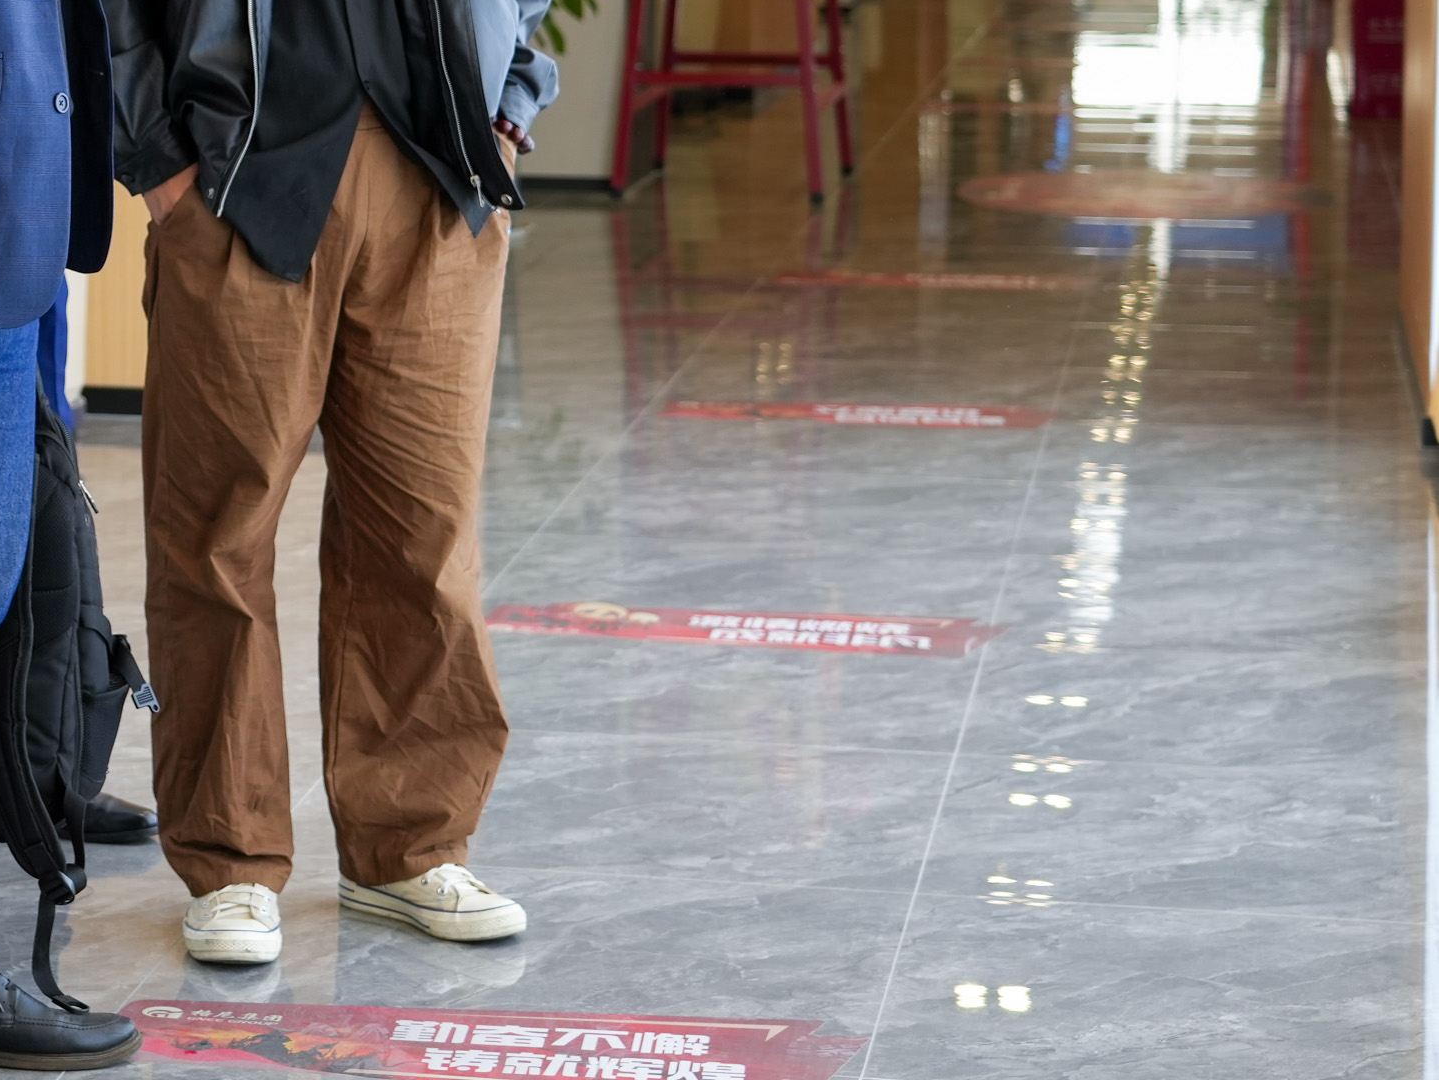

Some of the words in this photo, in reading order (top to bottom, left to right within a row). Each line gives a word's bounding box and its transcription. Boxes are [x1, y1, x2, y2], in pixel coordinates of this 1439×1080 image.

[389, 1019, 711, 1056] 勤奋不懈
[421, 1048, 746, 1080] 铸就辉煌
